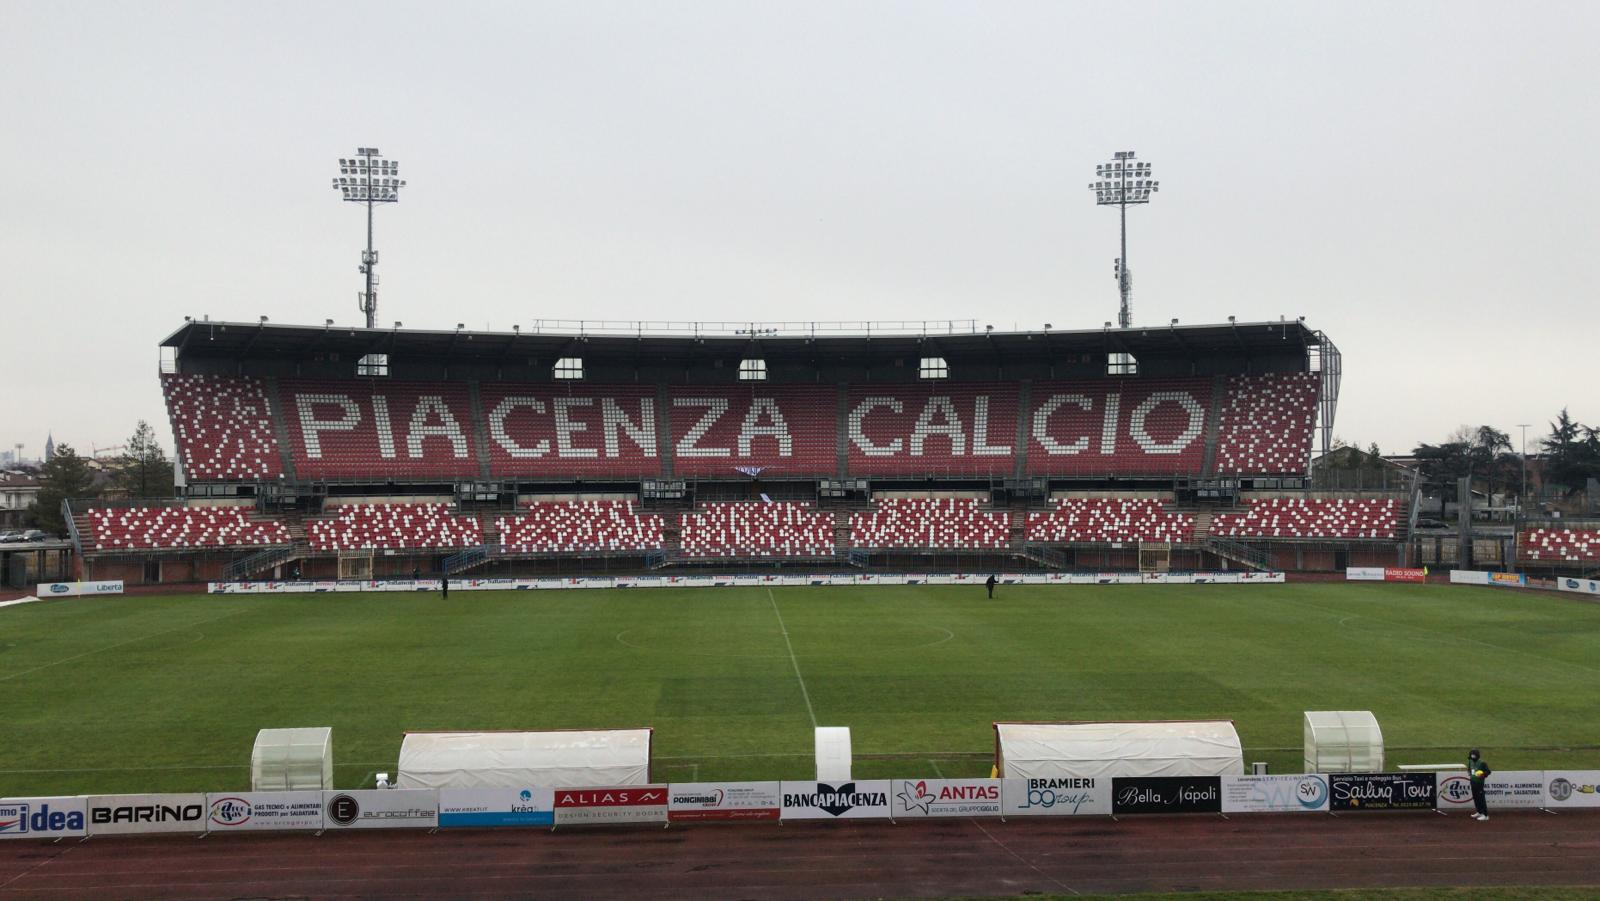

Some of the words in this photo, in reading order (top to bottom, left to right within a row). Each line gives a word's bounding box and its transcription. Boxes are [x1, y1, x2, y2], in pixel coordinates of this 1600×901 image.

[296, 393, 792, 458] PIACENZA
[848, 391, 1204, 456] CALCIO
[1030, 778, 1095, 789] BRAMIERI
[561, 793, 629, 804] ALIAS
[939, 786, 999, 800] ANTAS
[1117, 786, 1161, 805] Bella
[1164, 786, 1216, 804] Napoli
[1333, 781, 1393, 804] Sailing
[1393, 780, 1433, 798] Tour
[20, 804, 84, 831] idea
[363, 809, 436, 818] eurocoffee
